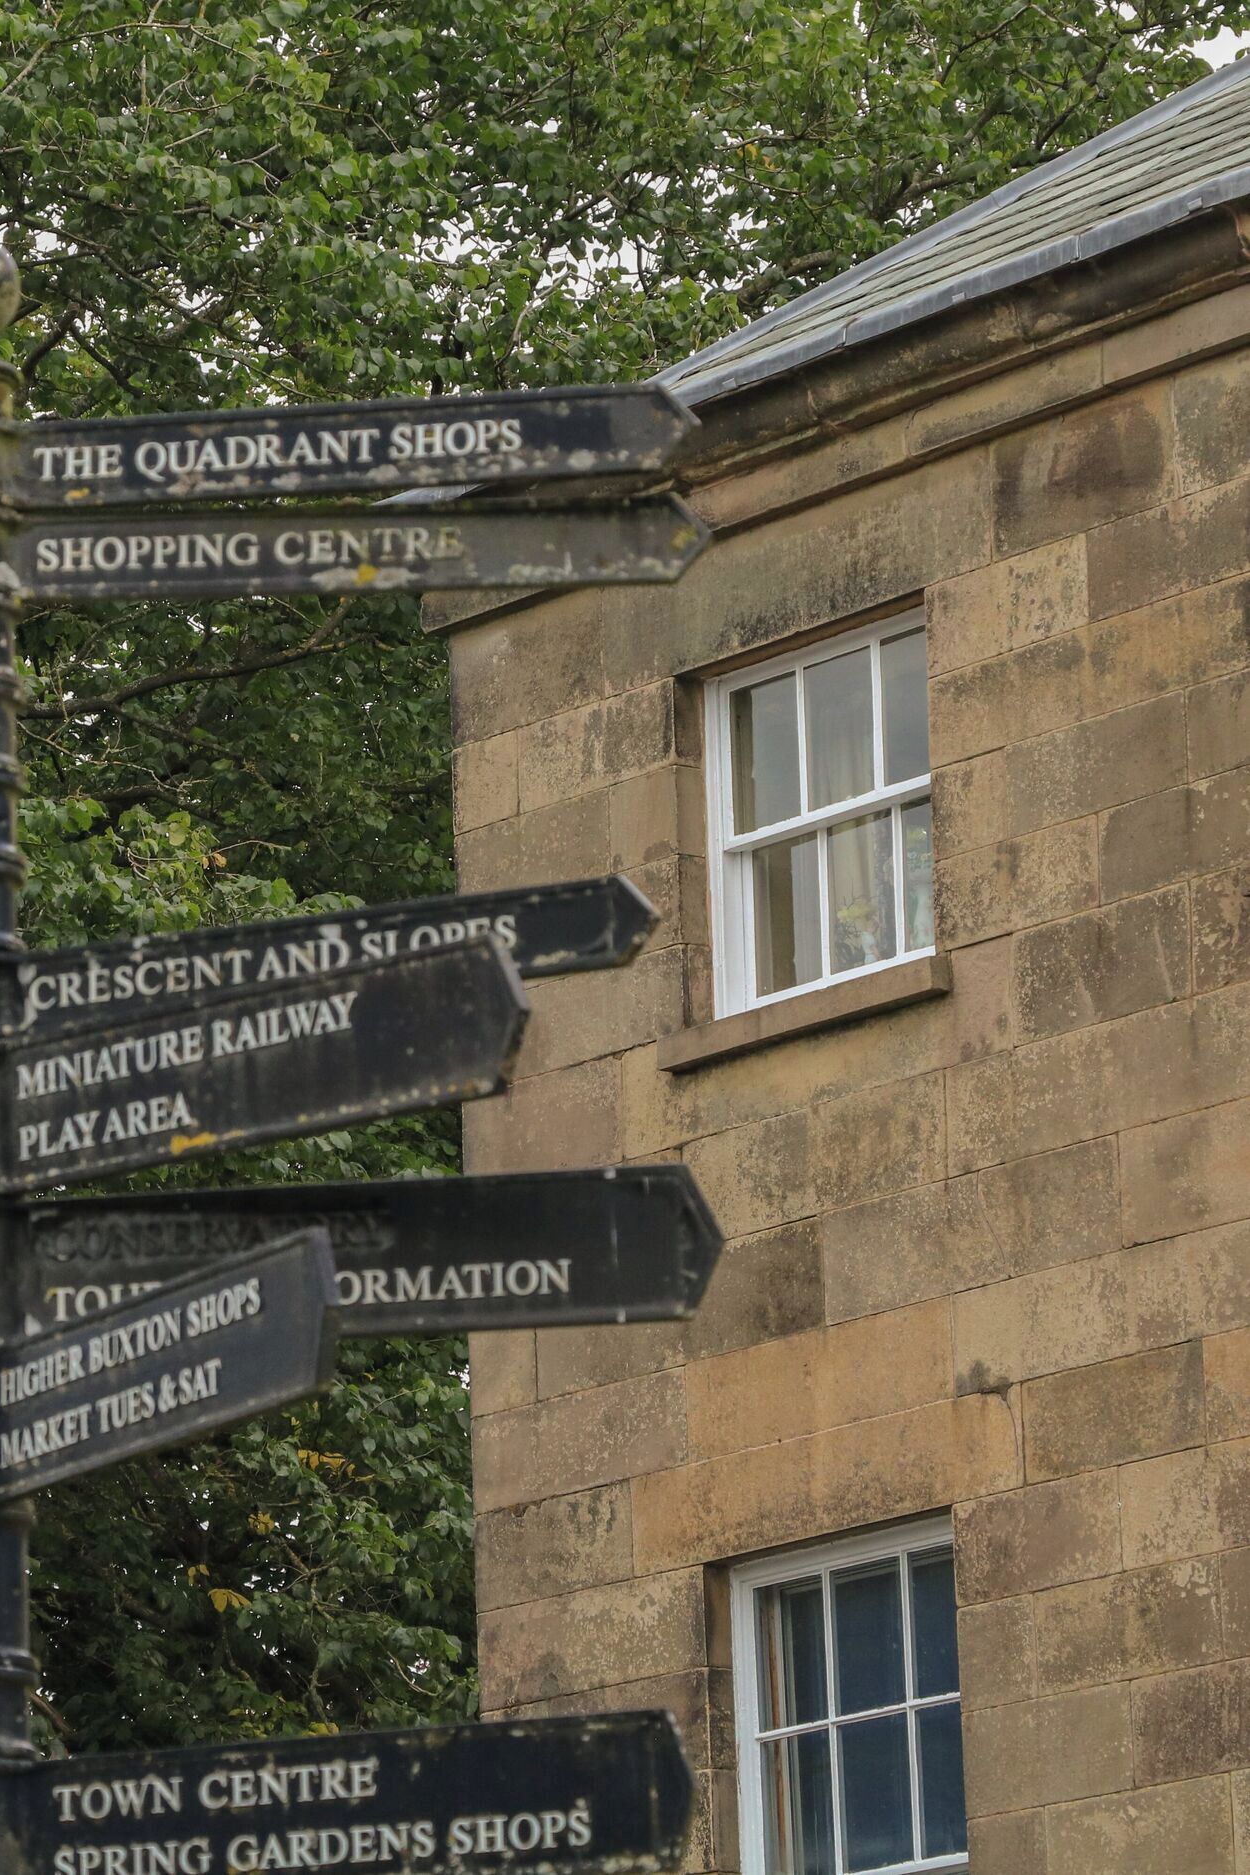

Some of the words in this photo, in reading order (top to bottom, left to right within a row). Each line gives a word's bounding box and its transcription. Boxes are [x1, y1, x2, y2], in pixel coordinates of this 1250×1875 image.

[34, 443, 122, 481] THE
[134, 426, 380, 479] QUADRANT
[389, 418, 522, 458] SHOPS
[36, 532, 259, 573] SHOPPING
[273, 526, 461, 567] CENTRE
[28, 949, 250, 1011] CRESCENT
[257, 936, 351, 982] AND
[16, 1024, 205, 1099] MINIATURE
[211, 991, 358, 1056] RAILWAY
[19, 1112, 102, 1161] PLAY
[106, 1093, 193, 1142] AREA
[0, 1344, 86, 1407] HIGHER
[88, 1308, 182, 1374] BUXTON
[186, 1277, 262, 1338] SHOPS
[0, 1403, 92, 1470] MARKET
[96, 1381, 156, 1434] TUES
[178, 1357, 222, 1405] SAT
[53, 1777, 184, 1822] TOWN
[198, 1757, 379, 1810] CENTRE
[53, 1836, 213, 1875] SPRING
[226, 1821, 436, 1872] GARDENS
[451, 1806, 592, 1856] SHOPS
